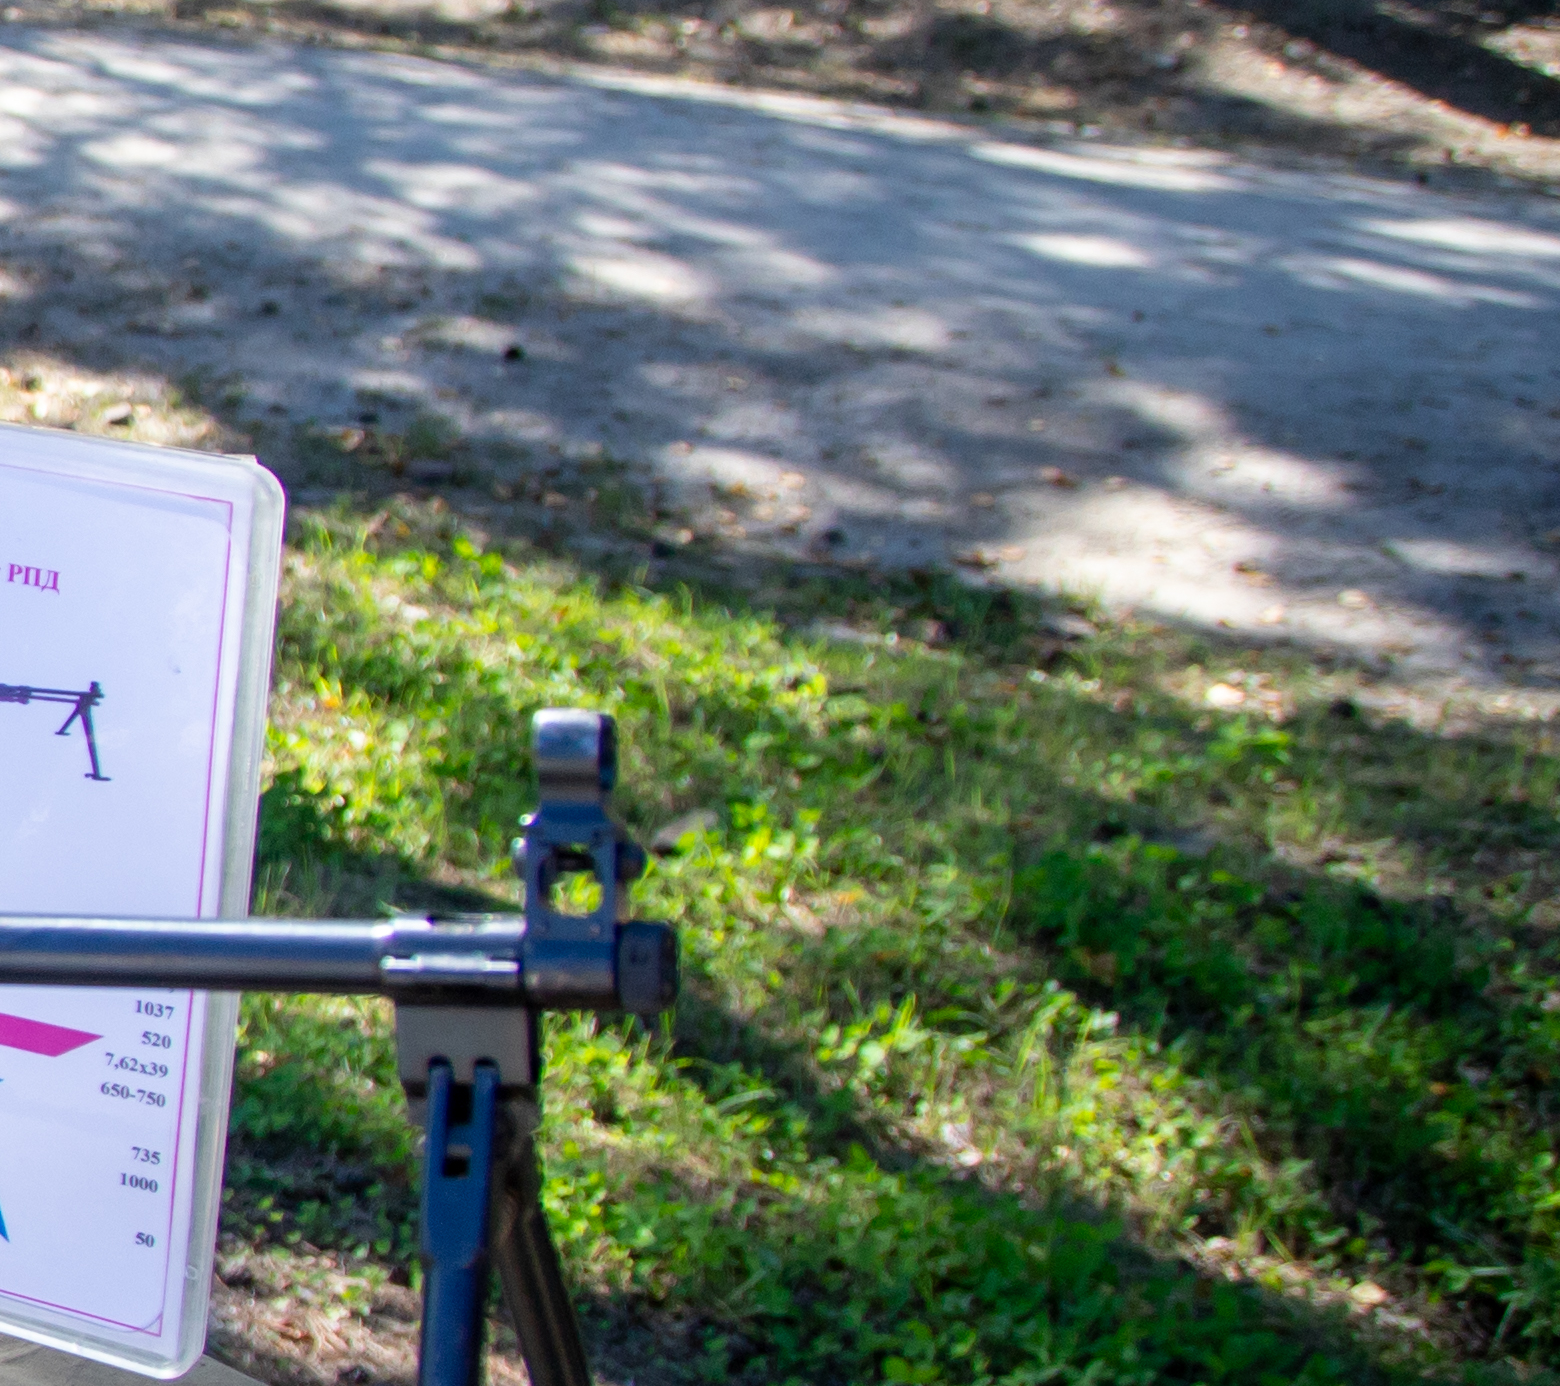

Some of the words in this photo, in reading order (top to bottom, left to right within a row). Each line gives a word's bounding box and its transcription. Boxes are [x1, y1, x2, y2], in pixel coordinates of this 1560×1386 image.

[8, 563, 61, 595] РПД
[135, 999, 175, 1020] 1037
[141, 1030, 171, 1049] 520
[100, 1081, 166, 1107] 650-750
[131, 1146, 162, 1165] 735
[120, 1172, 159, 1193] 1000
[135, 1231, 155, 1248] 50
